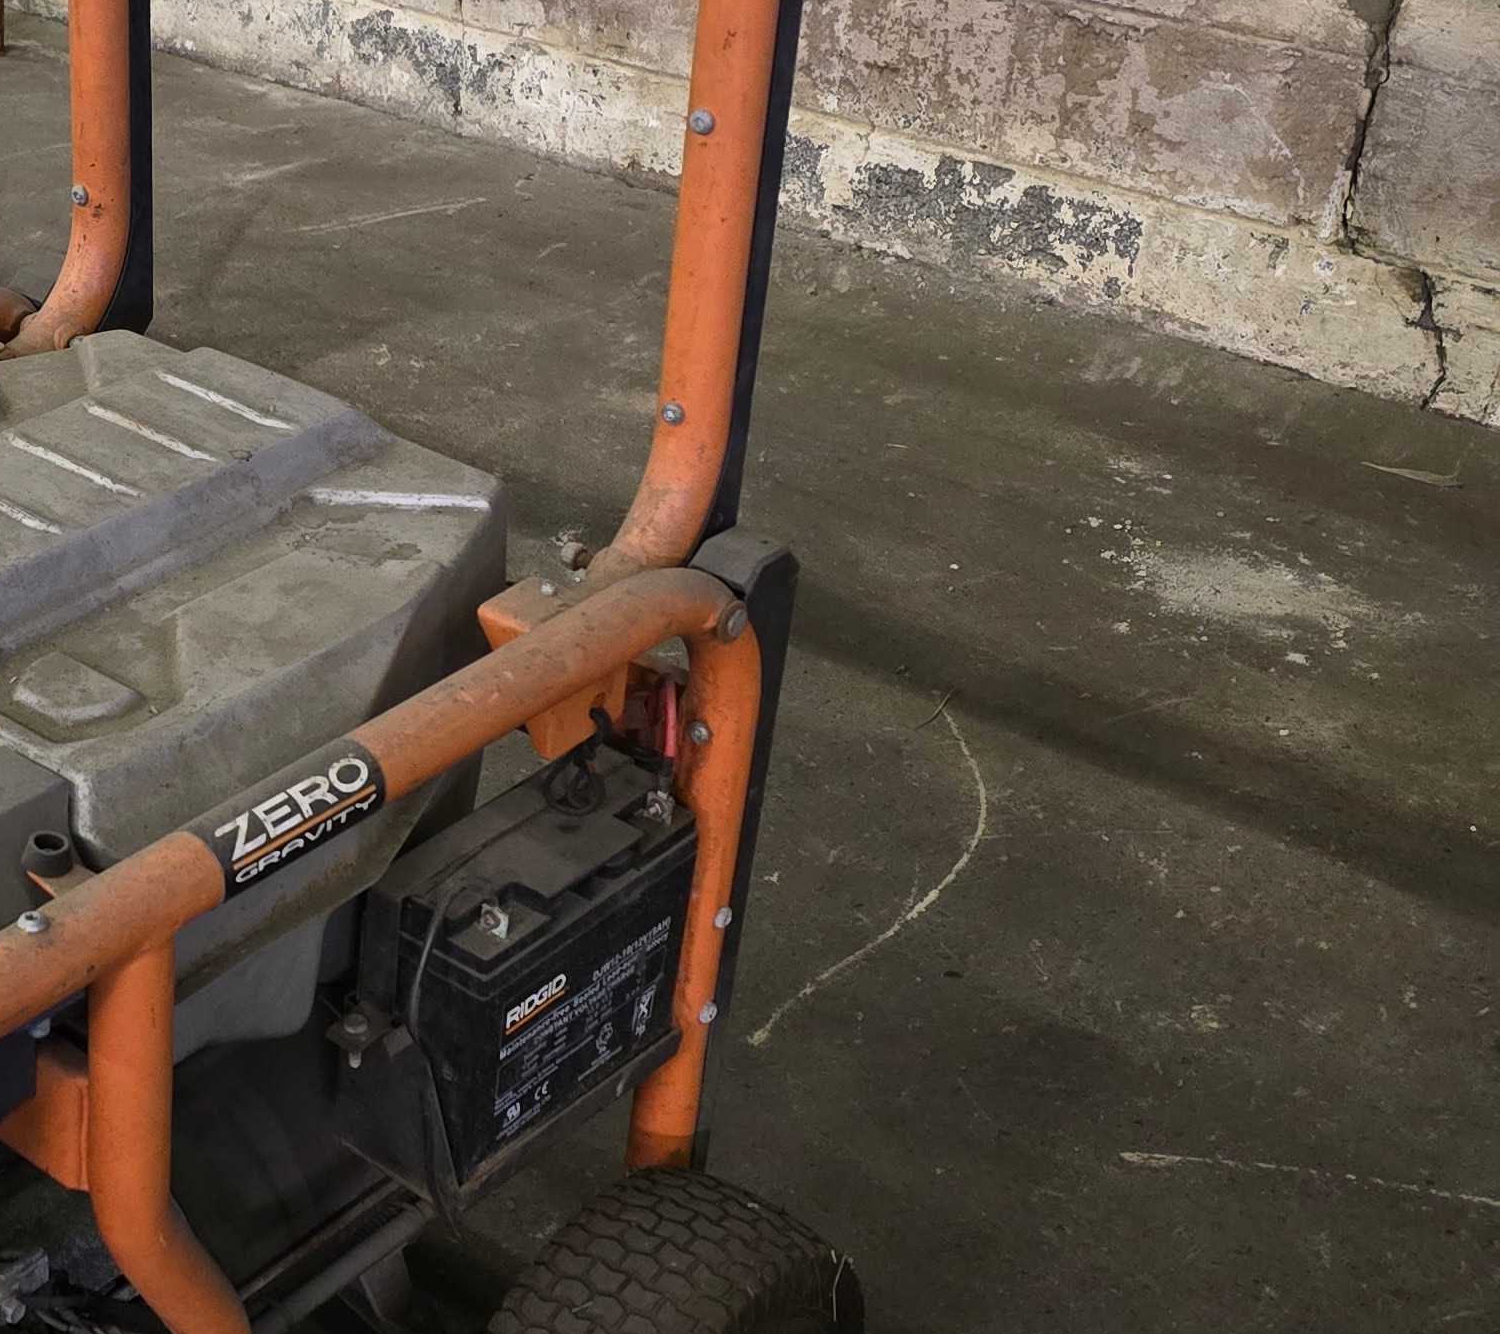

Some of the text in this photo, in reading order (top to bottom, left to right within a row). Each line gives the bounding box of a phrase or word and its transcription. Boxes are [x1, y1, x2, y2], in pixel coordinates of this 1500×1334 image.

[214, 757, 369, 861] ZERO
[236, 793, 378, 883] GRAVITY
[505, 973, 568, 1029] RIDGID
